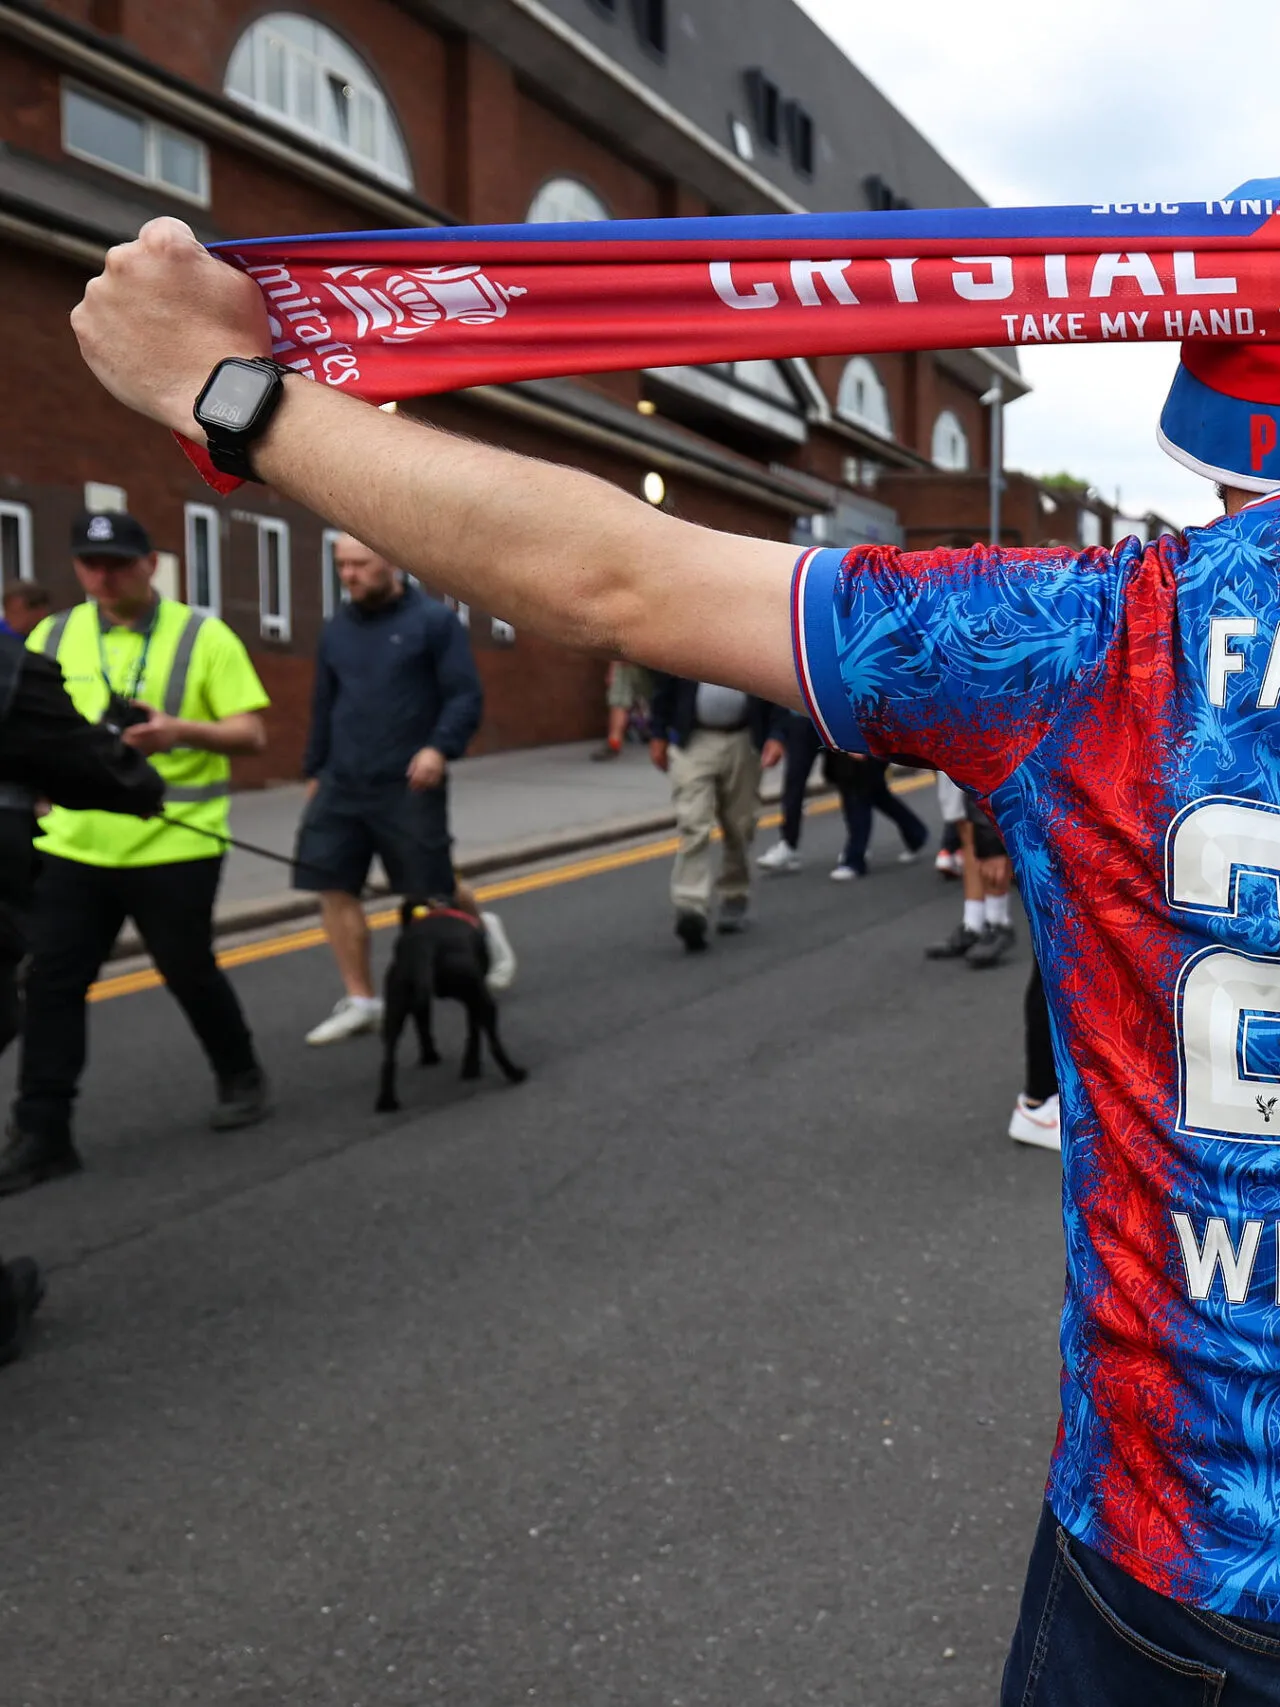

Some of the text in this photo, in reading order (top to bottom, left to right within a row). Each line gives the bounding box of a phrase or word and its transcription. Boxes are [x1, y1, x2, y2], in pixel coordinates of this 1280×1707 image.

[233, 253, 361, 386] mirates
[1001, 312, 1088, 342] TAKE
[1100, 310, 1149, 339] MY
[1163, 307, 1266, 337] HAND,
